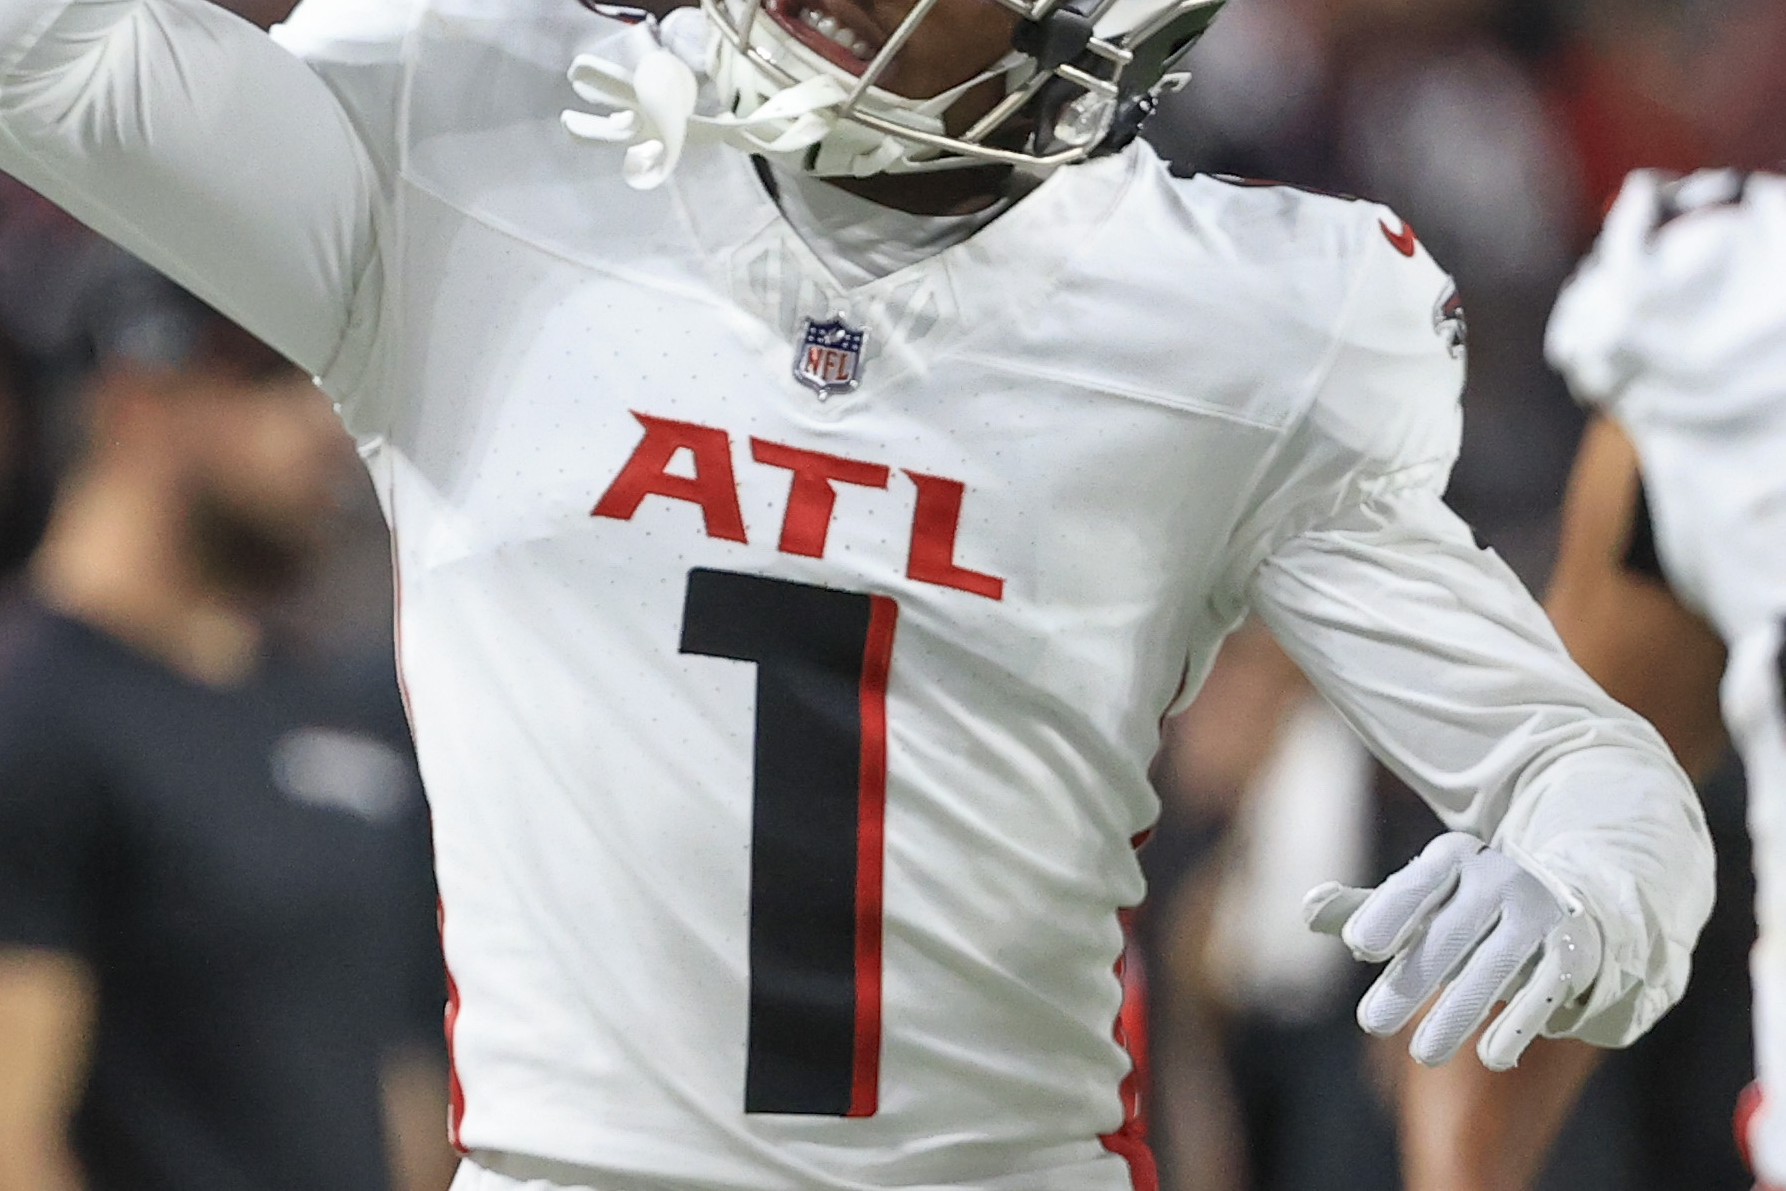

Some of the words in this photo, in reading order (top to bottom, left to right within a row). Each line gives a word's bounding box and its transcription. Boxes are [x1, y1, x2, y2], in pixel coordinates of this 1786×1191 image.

[805, 347, 850, 381] NFL
[591, 409, 1006, 601] ATL
[679, 566, 899, 1117] 1
